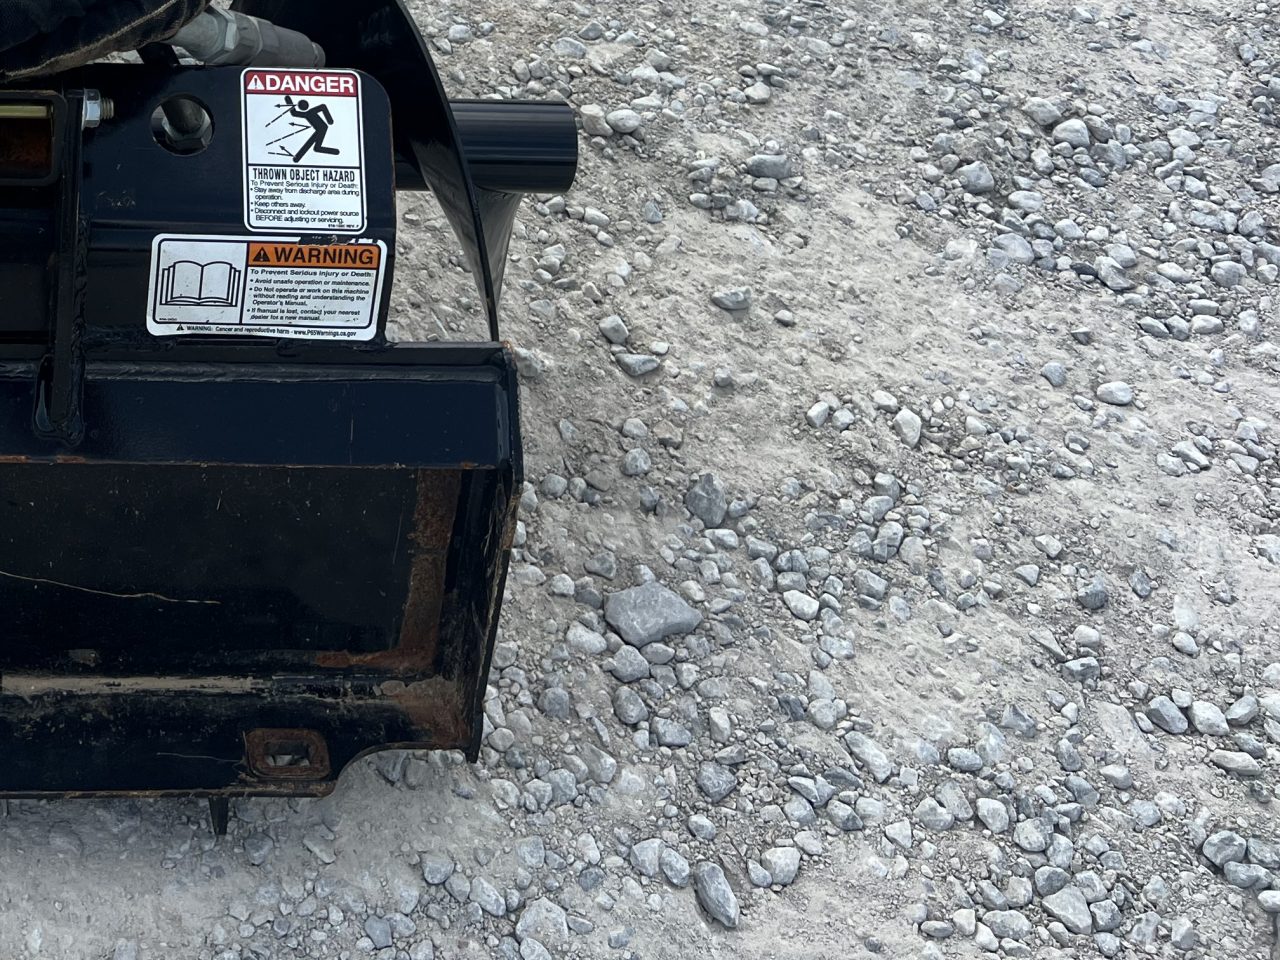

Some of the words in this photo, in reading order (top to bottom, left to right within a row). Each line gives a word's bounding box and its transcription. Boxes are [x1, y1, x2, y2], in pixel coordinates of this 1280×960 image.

[266, 75, 355, 93] DANGER
[253, 168, 287, 180] THROWN
[290, 169, 320, 181] OBJECT
[323, 170, 355, 182] HAZARD
[299, 188, 326, 196] discharge
[342, 189, 360, 197] during
[284, 215, 310, 224] adjusting
[274, 247, 374, 265] WARNING
[319, 270, 339, 278] Injury
